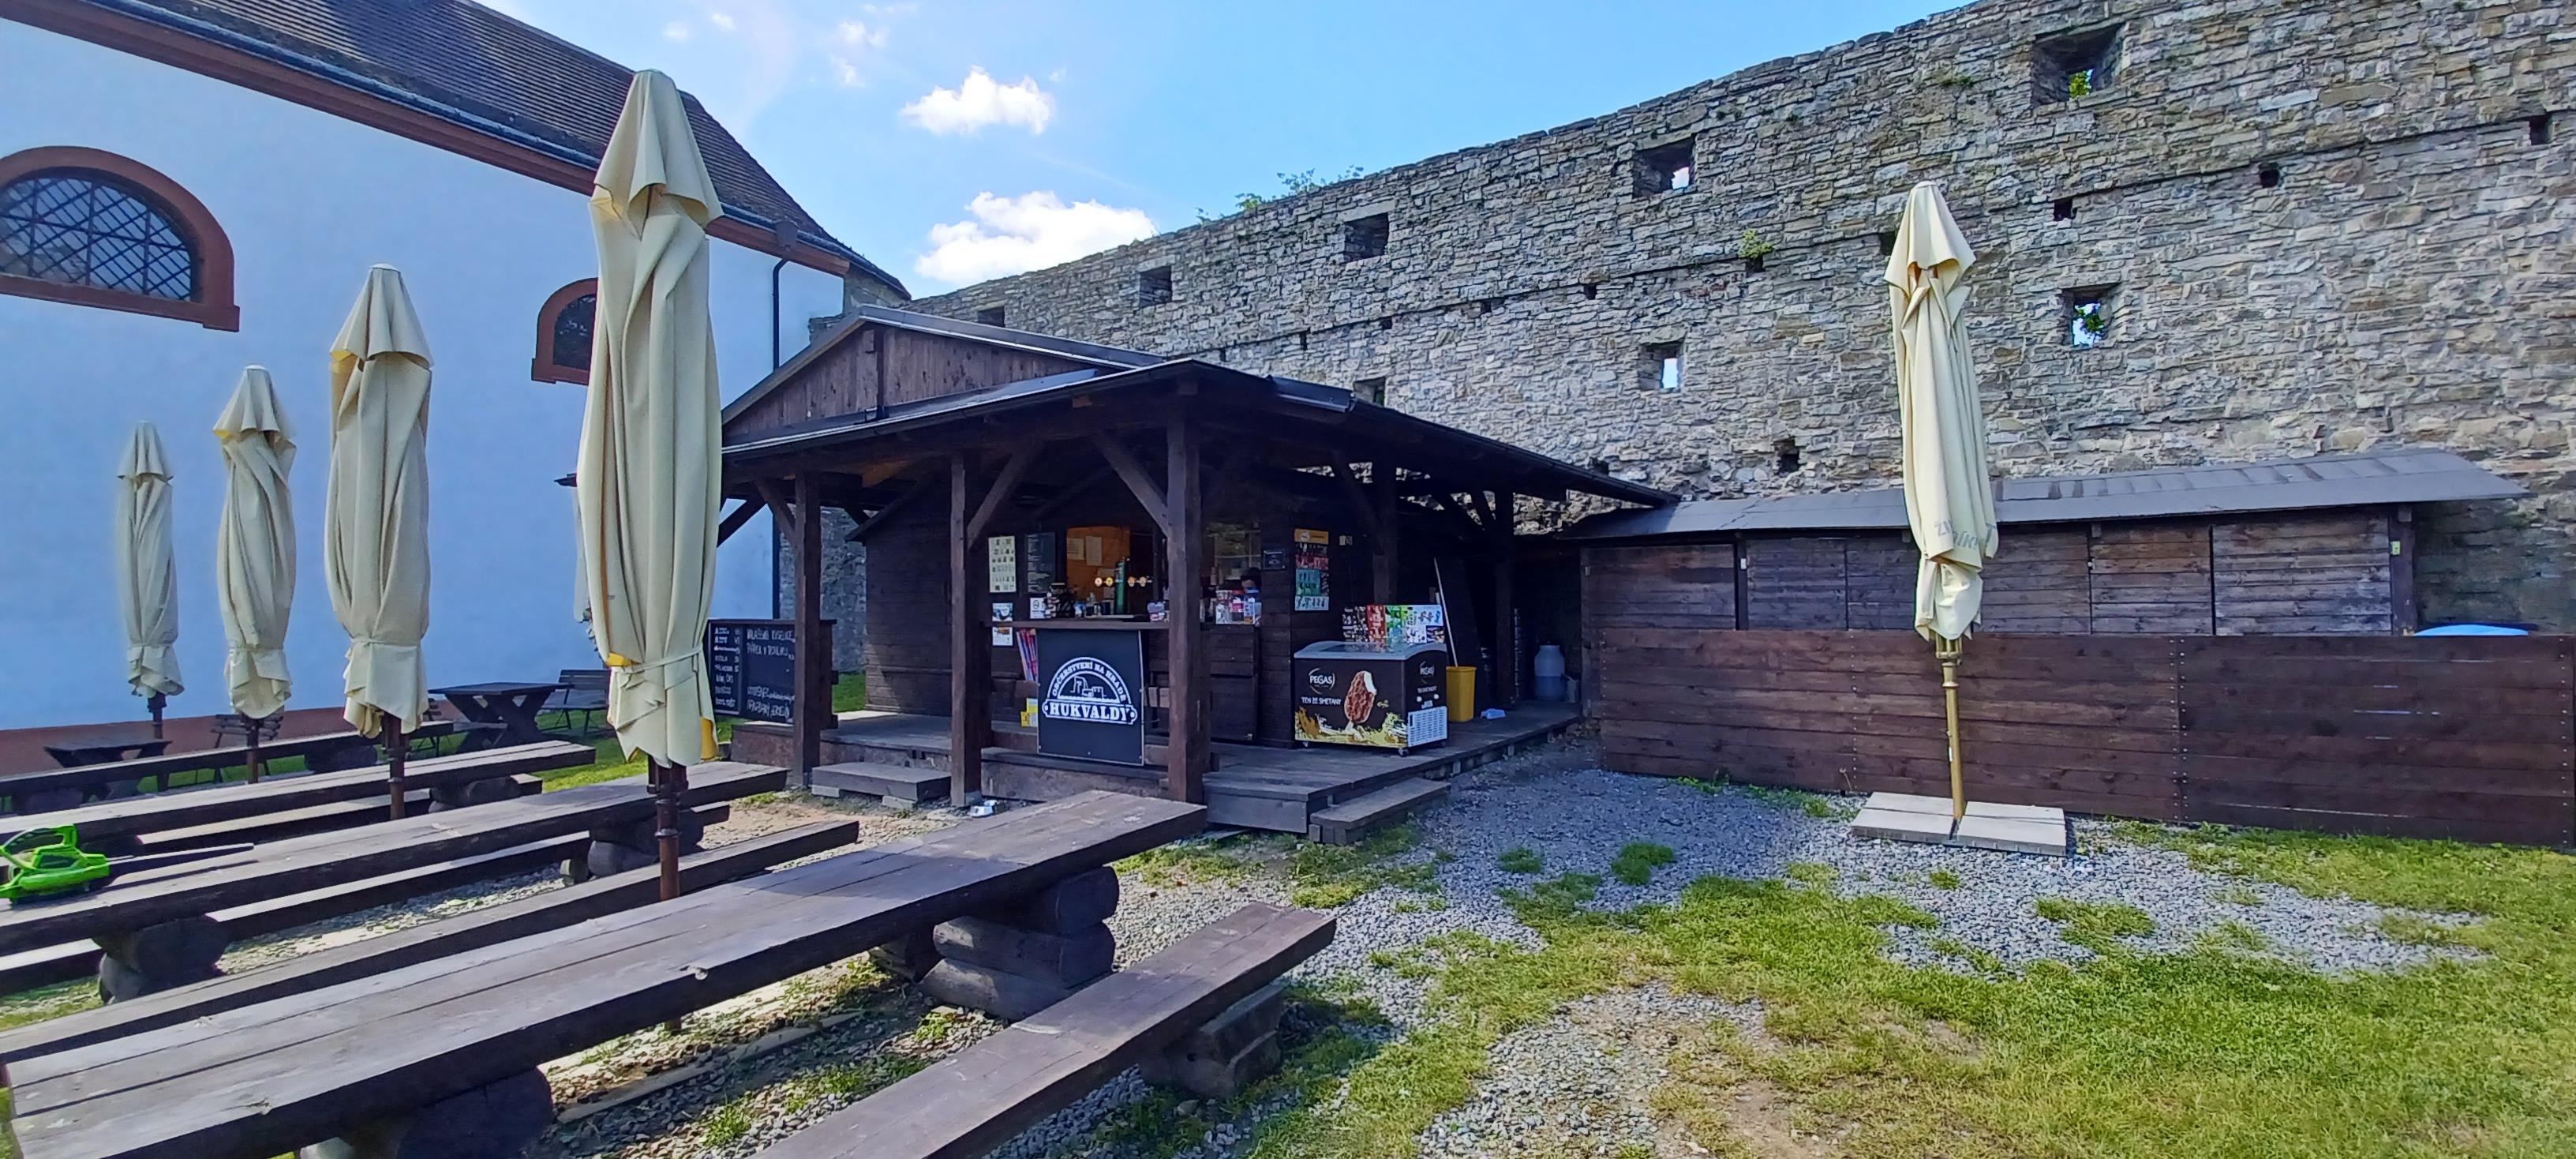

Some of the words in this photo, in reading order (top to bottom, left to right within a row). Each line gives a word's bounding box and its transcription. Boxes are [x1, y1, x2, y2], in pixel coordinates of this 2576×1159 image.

[1095, 663, 1105, 674] NA
[1310, 675, 1333, 685] PEGAS
[1050, 703, 1130, 722] HUKVALDY
